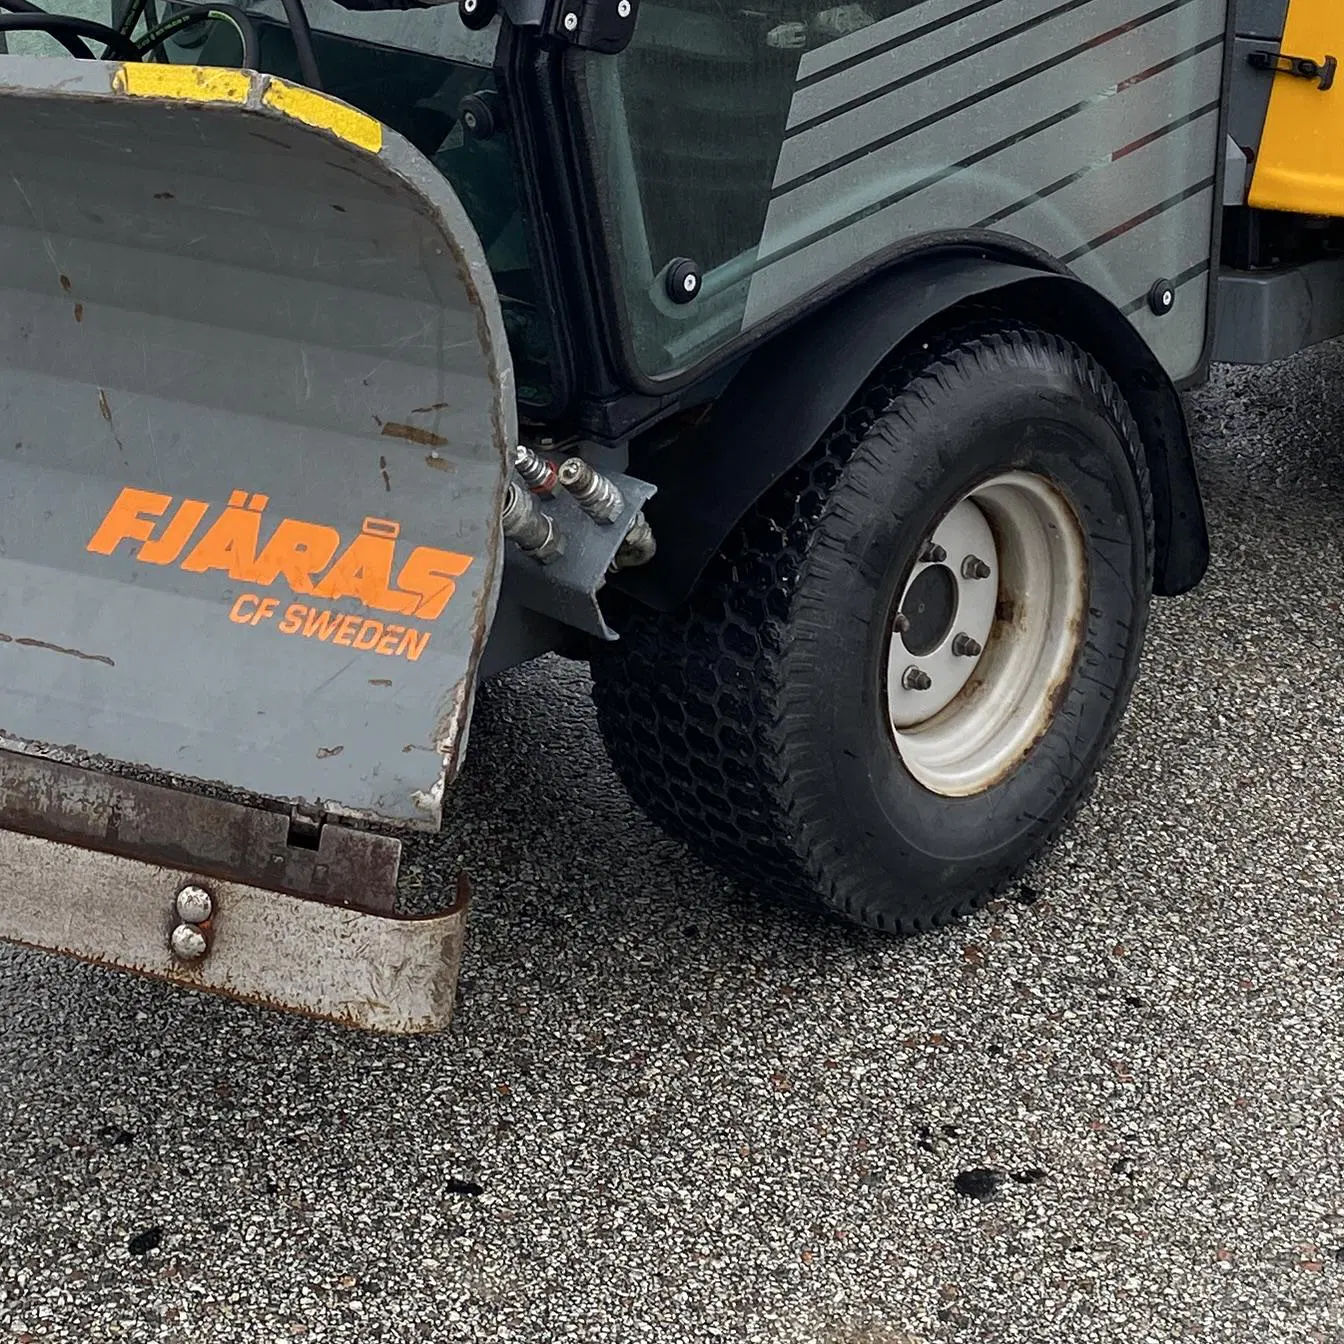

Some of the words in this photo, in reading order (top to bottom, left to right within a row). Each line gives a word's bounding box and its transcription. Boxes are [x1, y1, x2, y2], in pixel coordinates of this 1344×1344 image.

[86, 487, 475, 620] FJÄRÅS
[228, 594, 281, 626] CF
[278, 603, 431, 662] SWEDEN
